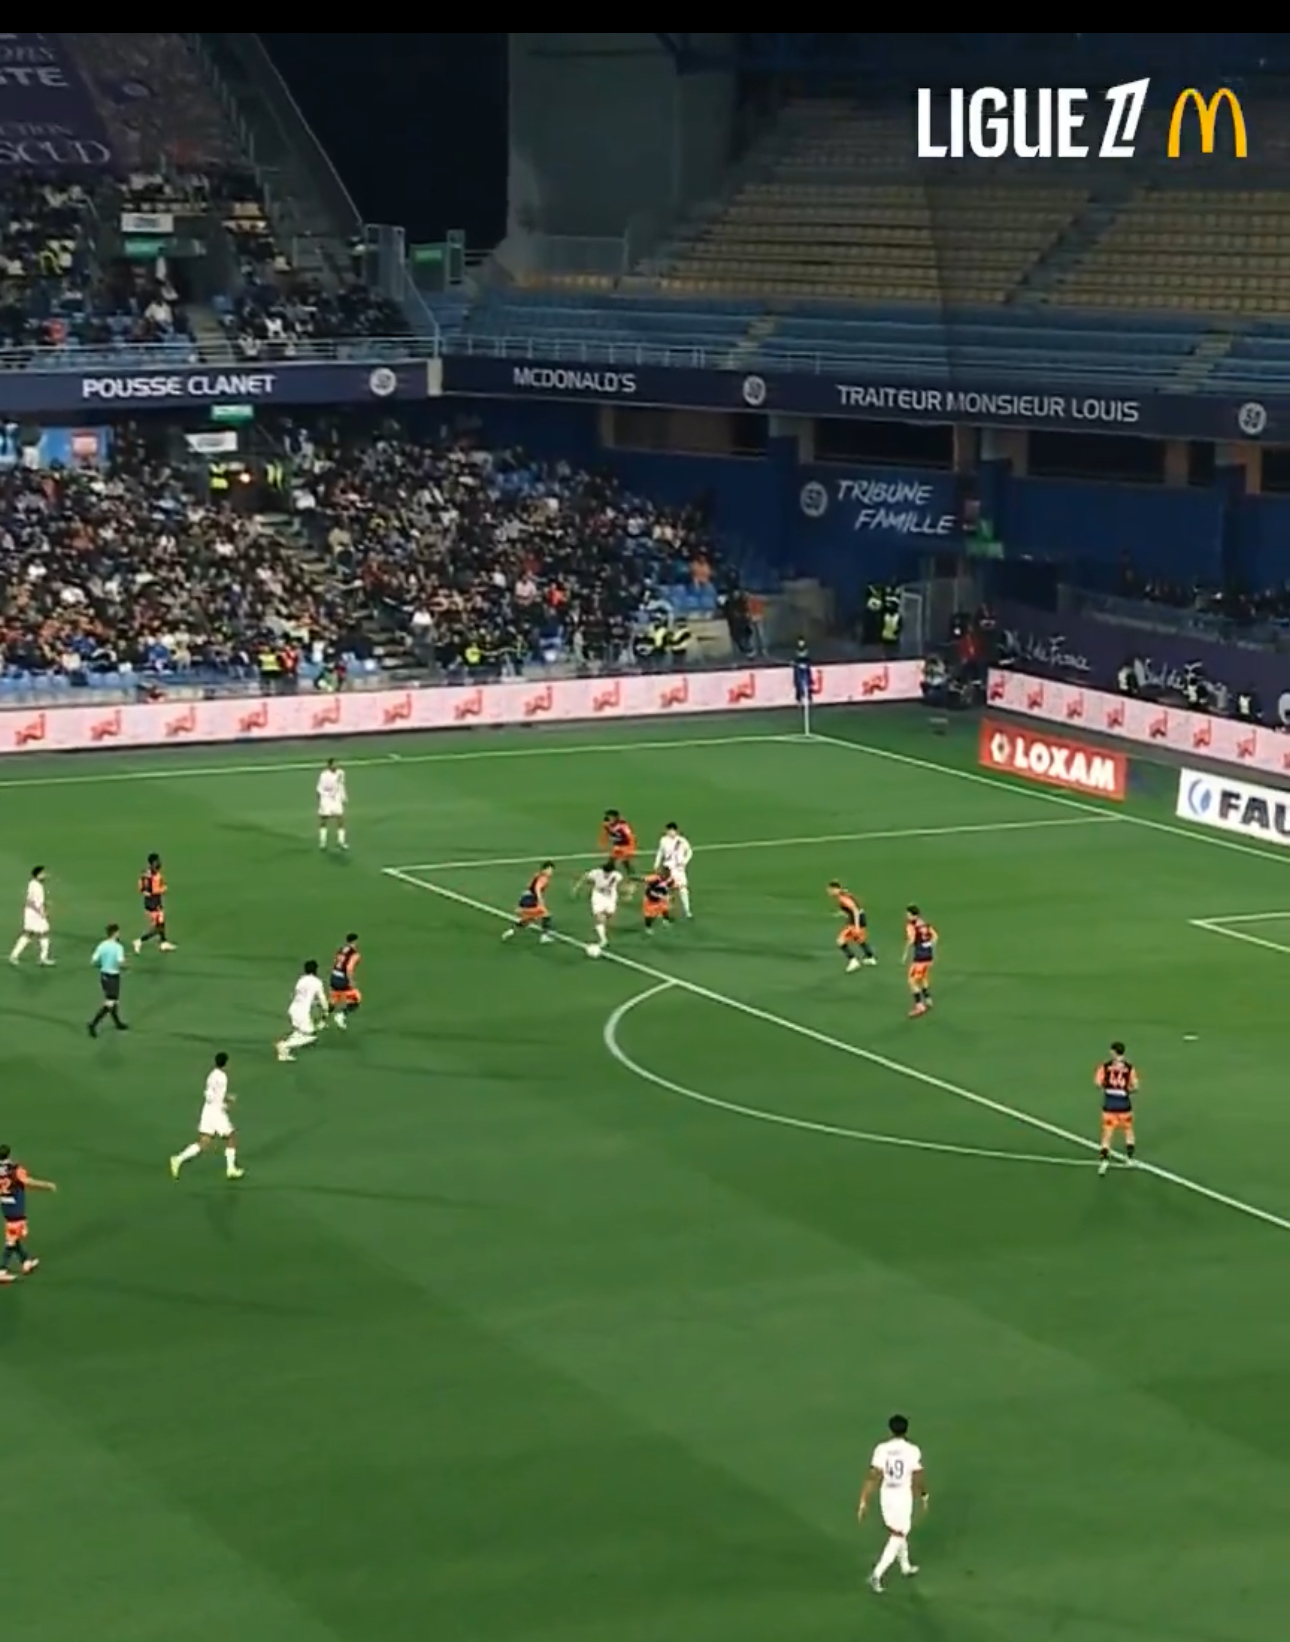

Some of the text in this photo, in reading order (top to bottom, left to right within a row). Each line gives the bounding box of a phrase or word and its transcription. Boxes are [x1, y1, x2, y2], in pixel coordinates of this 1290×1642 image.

[82, 373, 277, 398] POUSSE CLANET
[513, 367, 637, 393] MCDONALD'S
[836, 384, 1140, 423] TRAITEUR MONSIEUR LOUIS
[836, 479, 935, 505] TRIBUNE
[853, 508, 956, 535] FAMILLE
[1014, 737, 1116, 791] LOXAM
